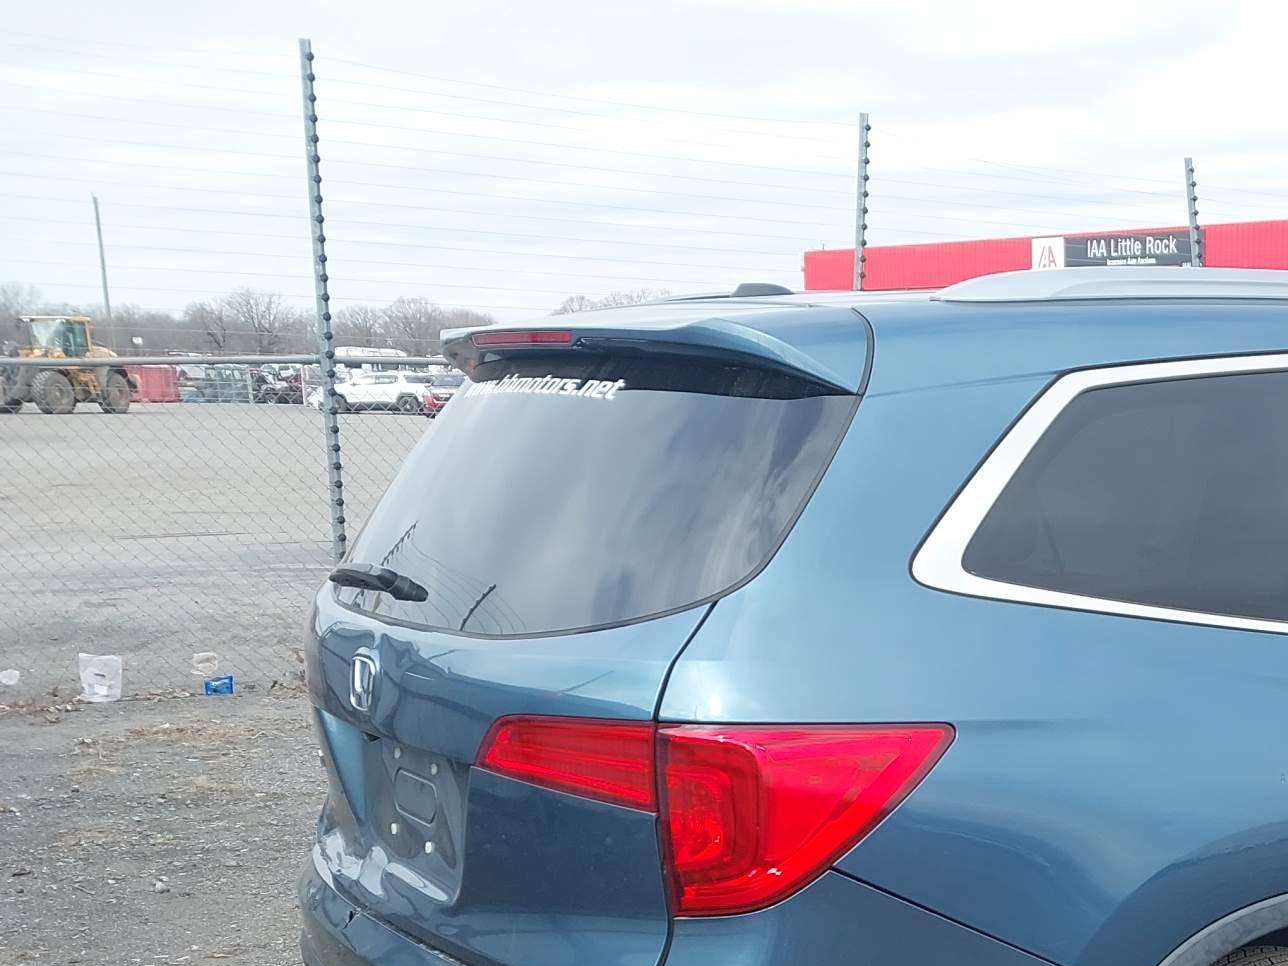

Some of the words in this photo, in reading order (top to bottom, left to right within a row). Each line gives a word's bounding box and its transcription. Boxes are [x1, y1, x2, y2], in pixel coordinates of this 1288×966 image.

[1087, 239, 1107, 258] IAA
[1111, 237, 1142, 257] Little
[1146, 234, 1178, 255] Rock
